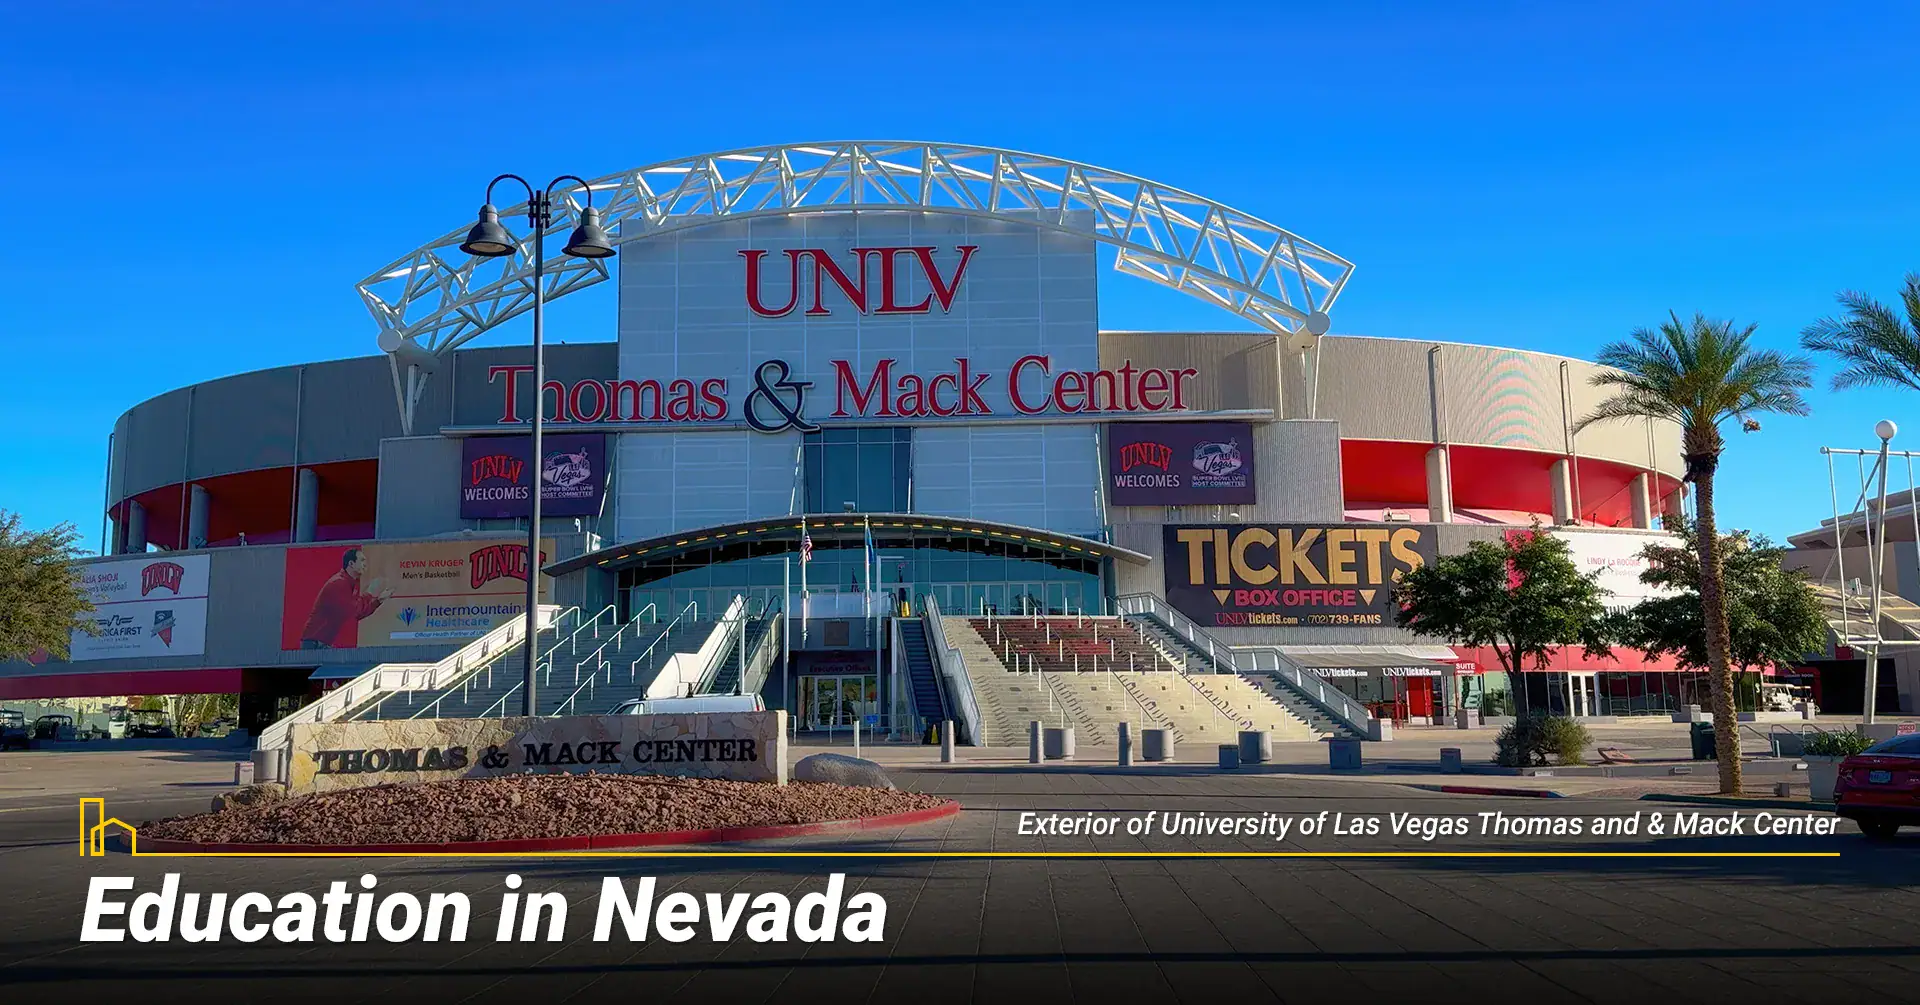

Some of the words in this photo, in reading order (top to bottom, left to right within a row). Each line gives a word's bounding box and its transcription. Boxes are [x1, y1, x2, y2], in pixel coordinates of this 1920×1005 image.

[738, 245, 980, 318] UNLV
[488, 364, 729, 424] Thomas
[743, 359, 820, 434] &
[829, 356, 994, 418] Mack
[1007, 354, 1200, 415] Center
[1120, 442, 1173, 472] UNLV
[1200, 454, 1236, 474] Vegas
[472, 454, 524, 485] UNLV
[549, 464, 585, 484] Vegas
[1115, 474, 1180, 488] WELCOMES
[464, 487, 529, 501] WELCOMES
[400, 560, 427, 569] KEVIN
[428, 559, 464, 567] KRUGER
[1177, 527, 1425, 585] TICKETS
[1586, 557, 1606, 565] LINDY
[141, 561, 184, 597] UNLV
[402, 571, 423, 579] Men's
[424, 570, 460, 579] Basketball
[1235, 589, 1279, 606] BOX
[1282, 589, 1357, 606] OFFICE
[426, 602, 522, 617] Intermountain
[426, 617, 490, 628] Healthcare
[1215, 612, 1298, 625] UNLVtickets.com
[120, 626, 143, 636] FIRST
[1382, 667, 1442, 677] UNLVtickets.com
[315, 745, 468, 776] THOMAS
[481, 744, 510, 769] &
[522, 741, 622, 766] MACK
[632, 738, 758, 763] CENTER
